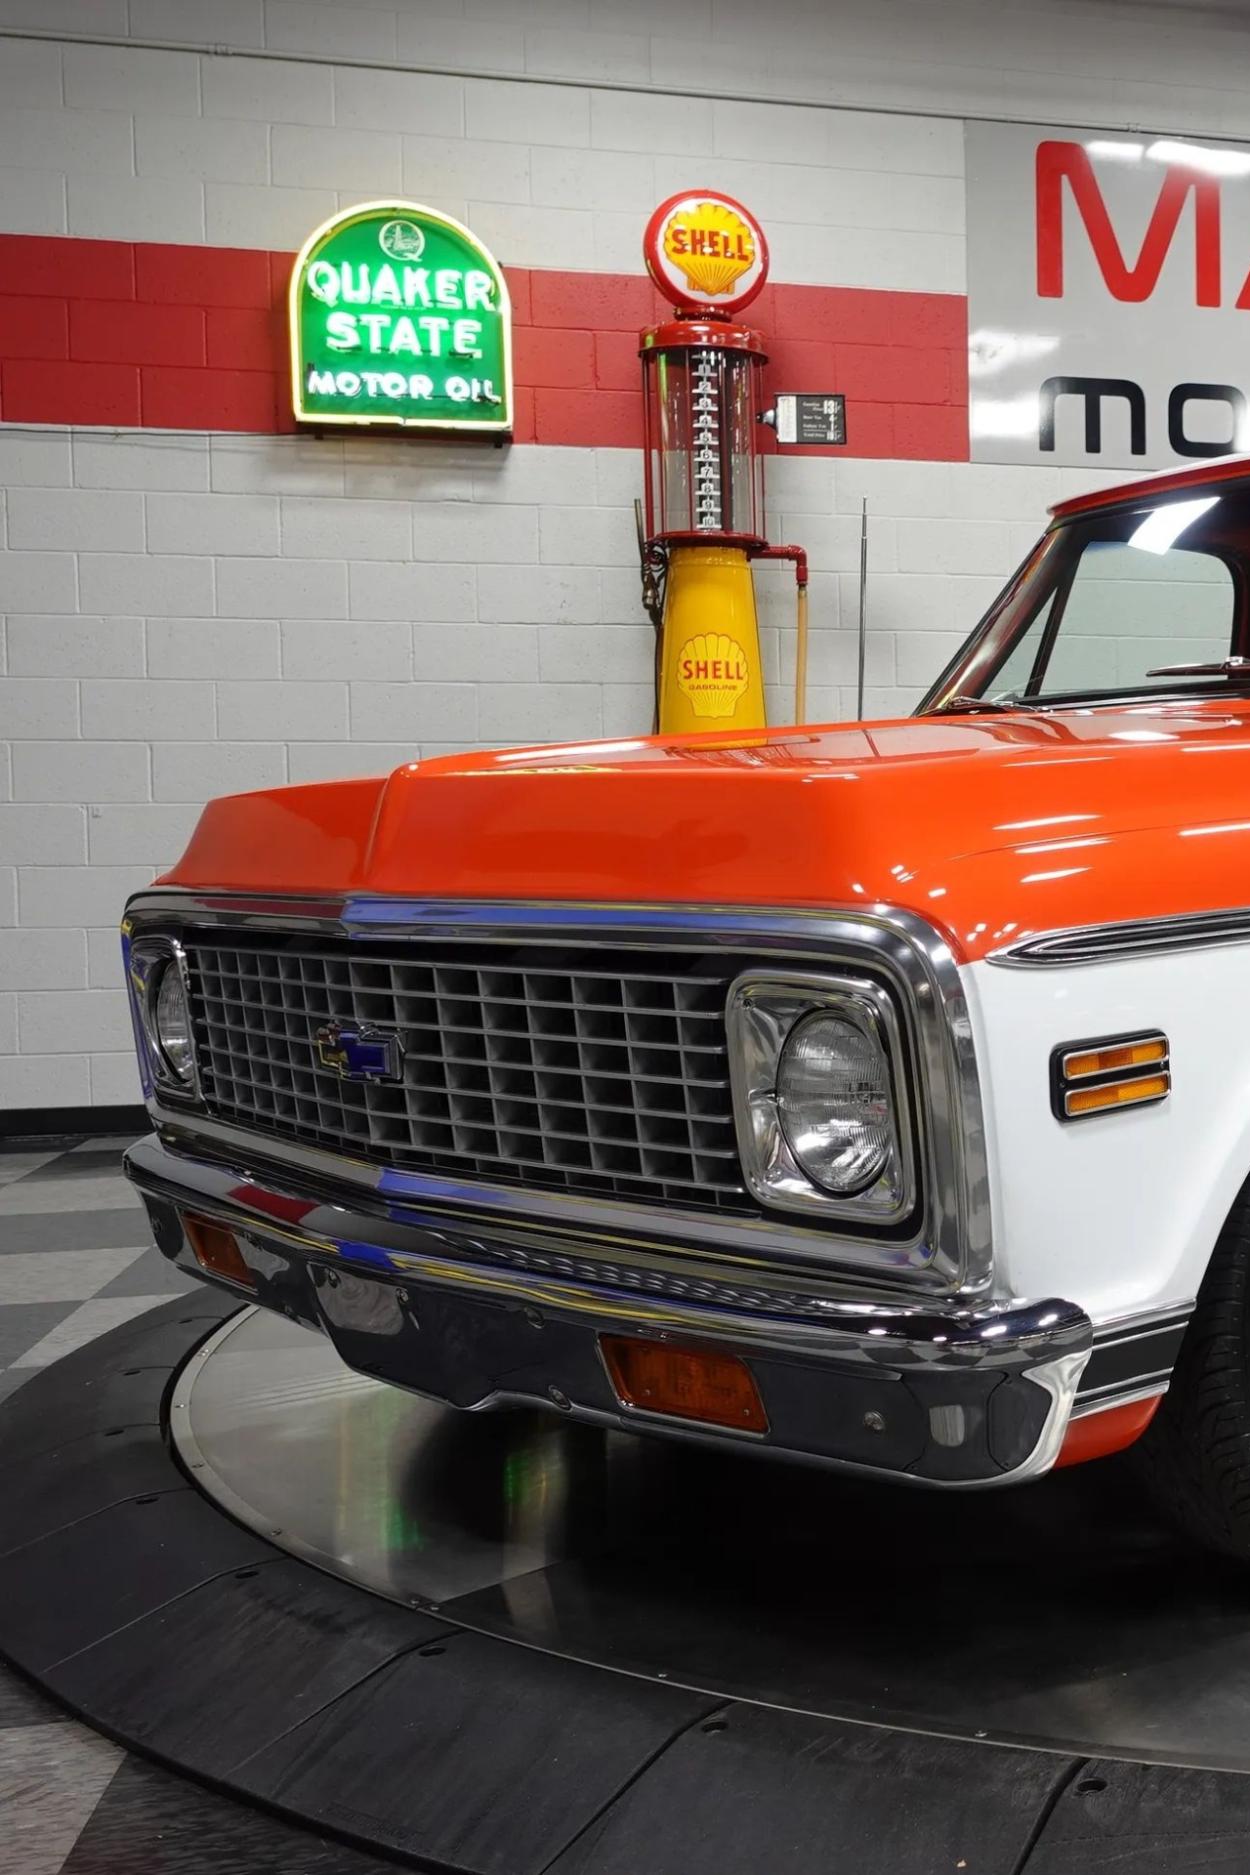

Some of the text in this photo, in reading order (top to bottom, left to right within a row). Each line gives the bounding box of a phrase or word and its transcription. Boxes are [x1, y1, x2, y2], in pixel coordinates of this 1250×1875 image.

[671, 228, 749, 262] SHELL
[307, 261, 496, 311] QUAKER
[326, 312, 482, 358] STATE
[308, 371, 501, 404] MOTOR OIL
[683, 660, 744, 680] SHELL
